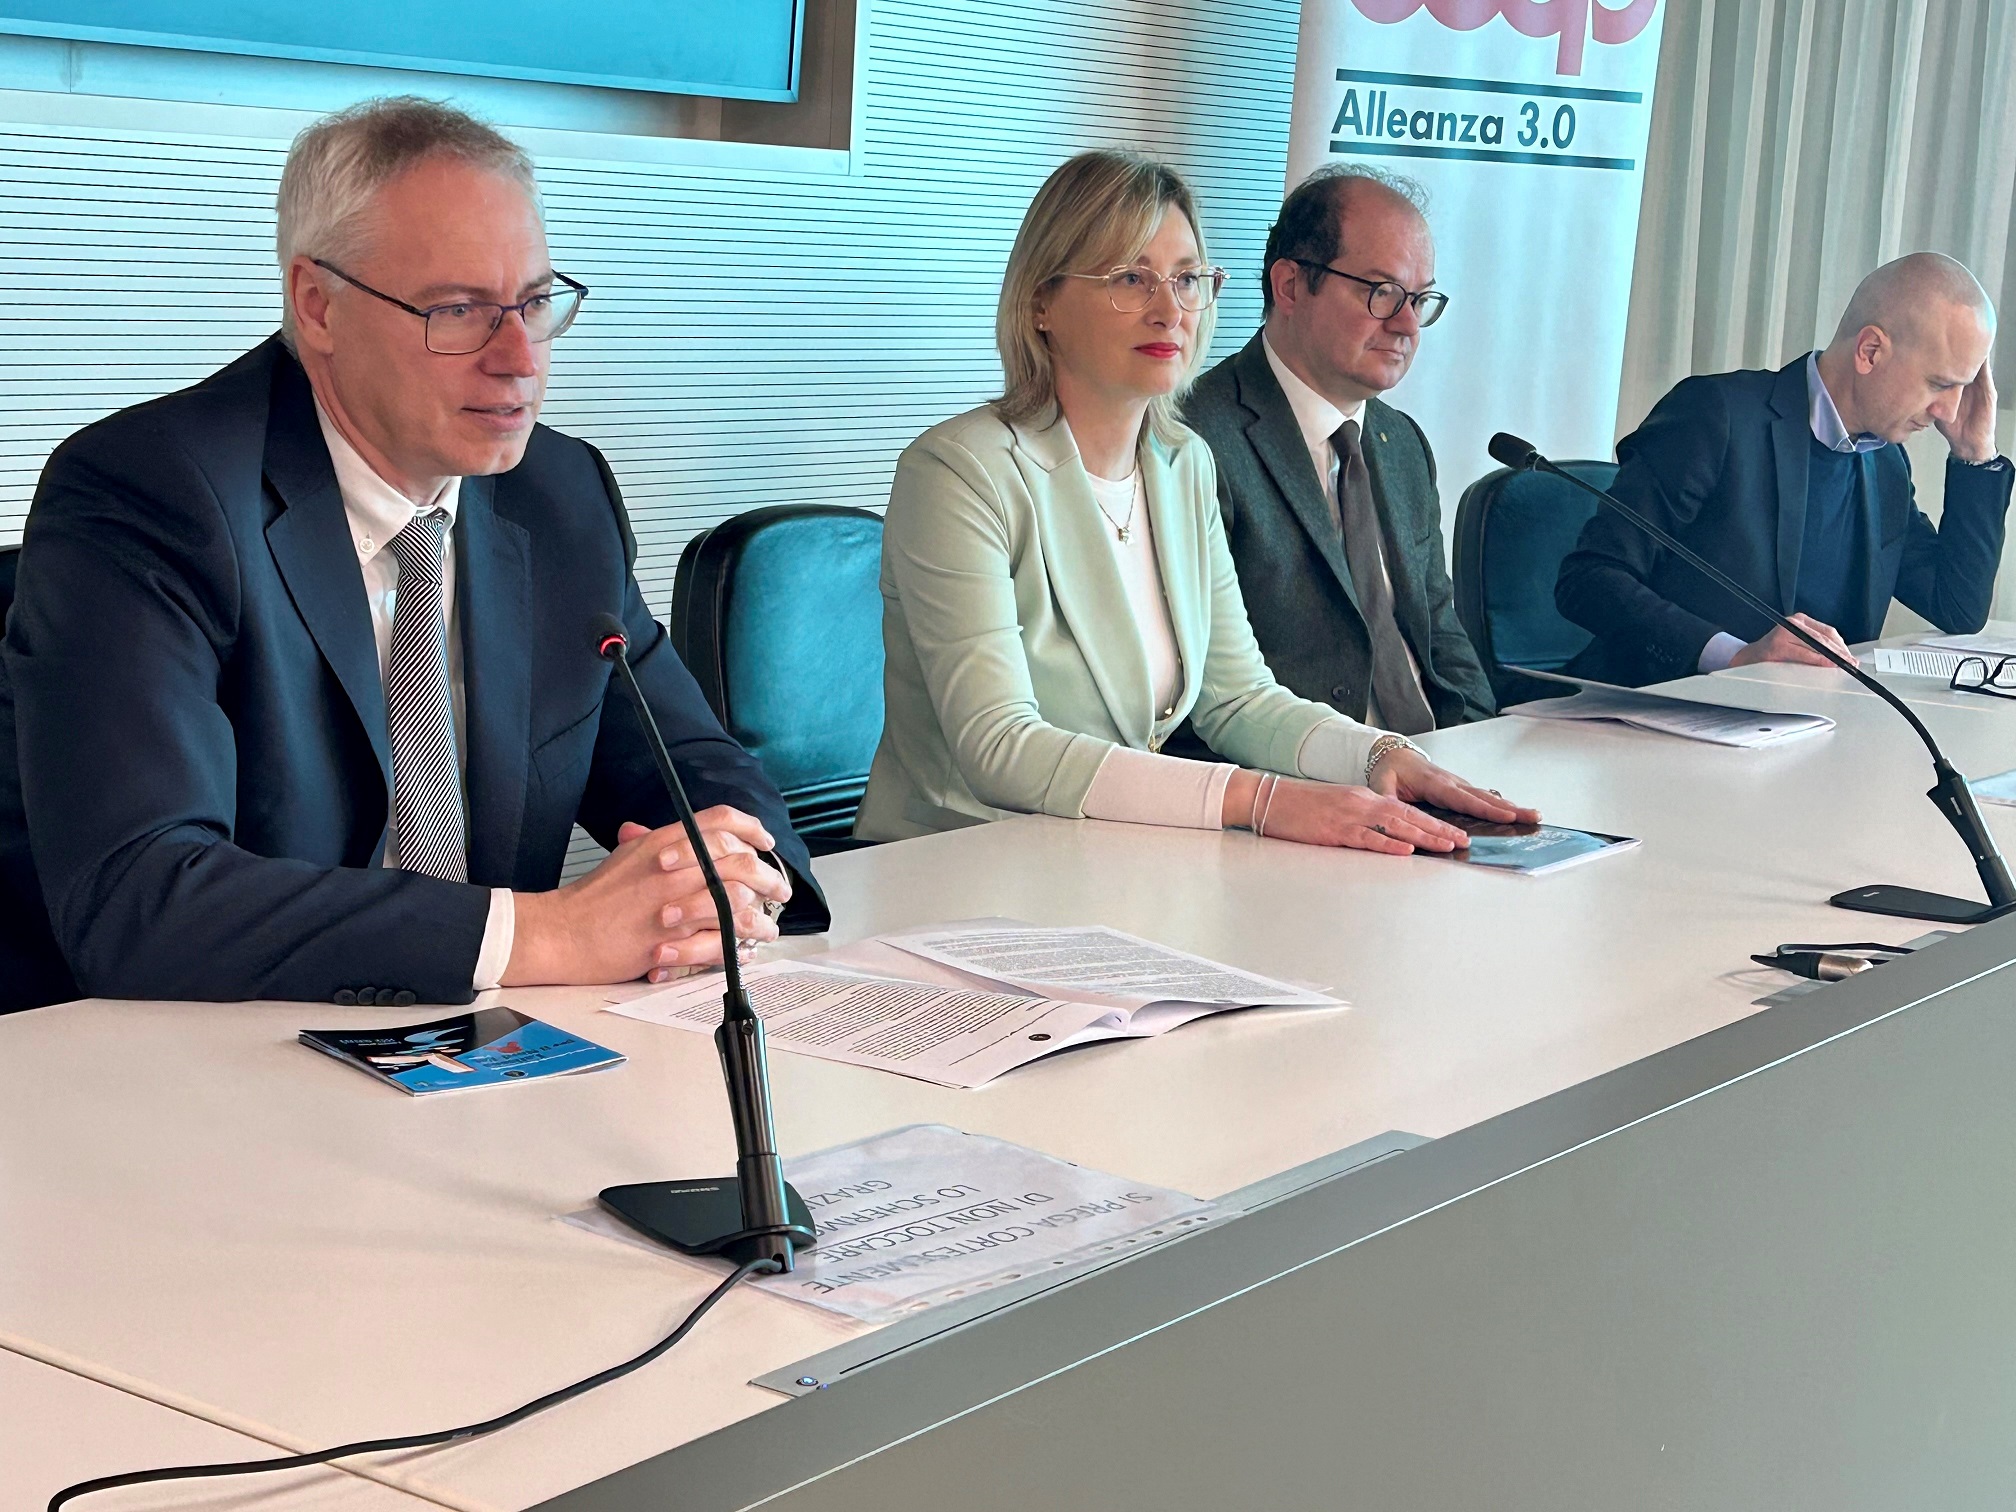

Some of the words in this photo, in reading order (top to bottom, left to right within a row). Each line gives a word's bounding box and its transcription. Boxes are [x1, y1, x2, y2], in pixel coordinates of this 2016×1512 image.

[1331, 88, 1504, 145] Alleanza
[1517, 101, 1576, 149] 3.0
[937, 1184, 981, 1198] LO
[1013, 1192, 1053, 1206] DI
[1118, 1192, 1152, 1210] SI
[949, 1199, 1021, 1228] NON
[1028, 1199, 1123, 1229] PREGA
[812, 1221, 956, 1263] TOCCARE
